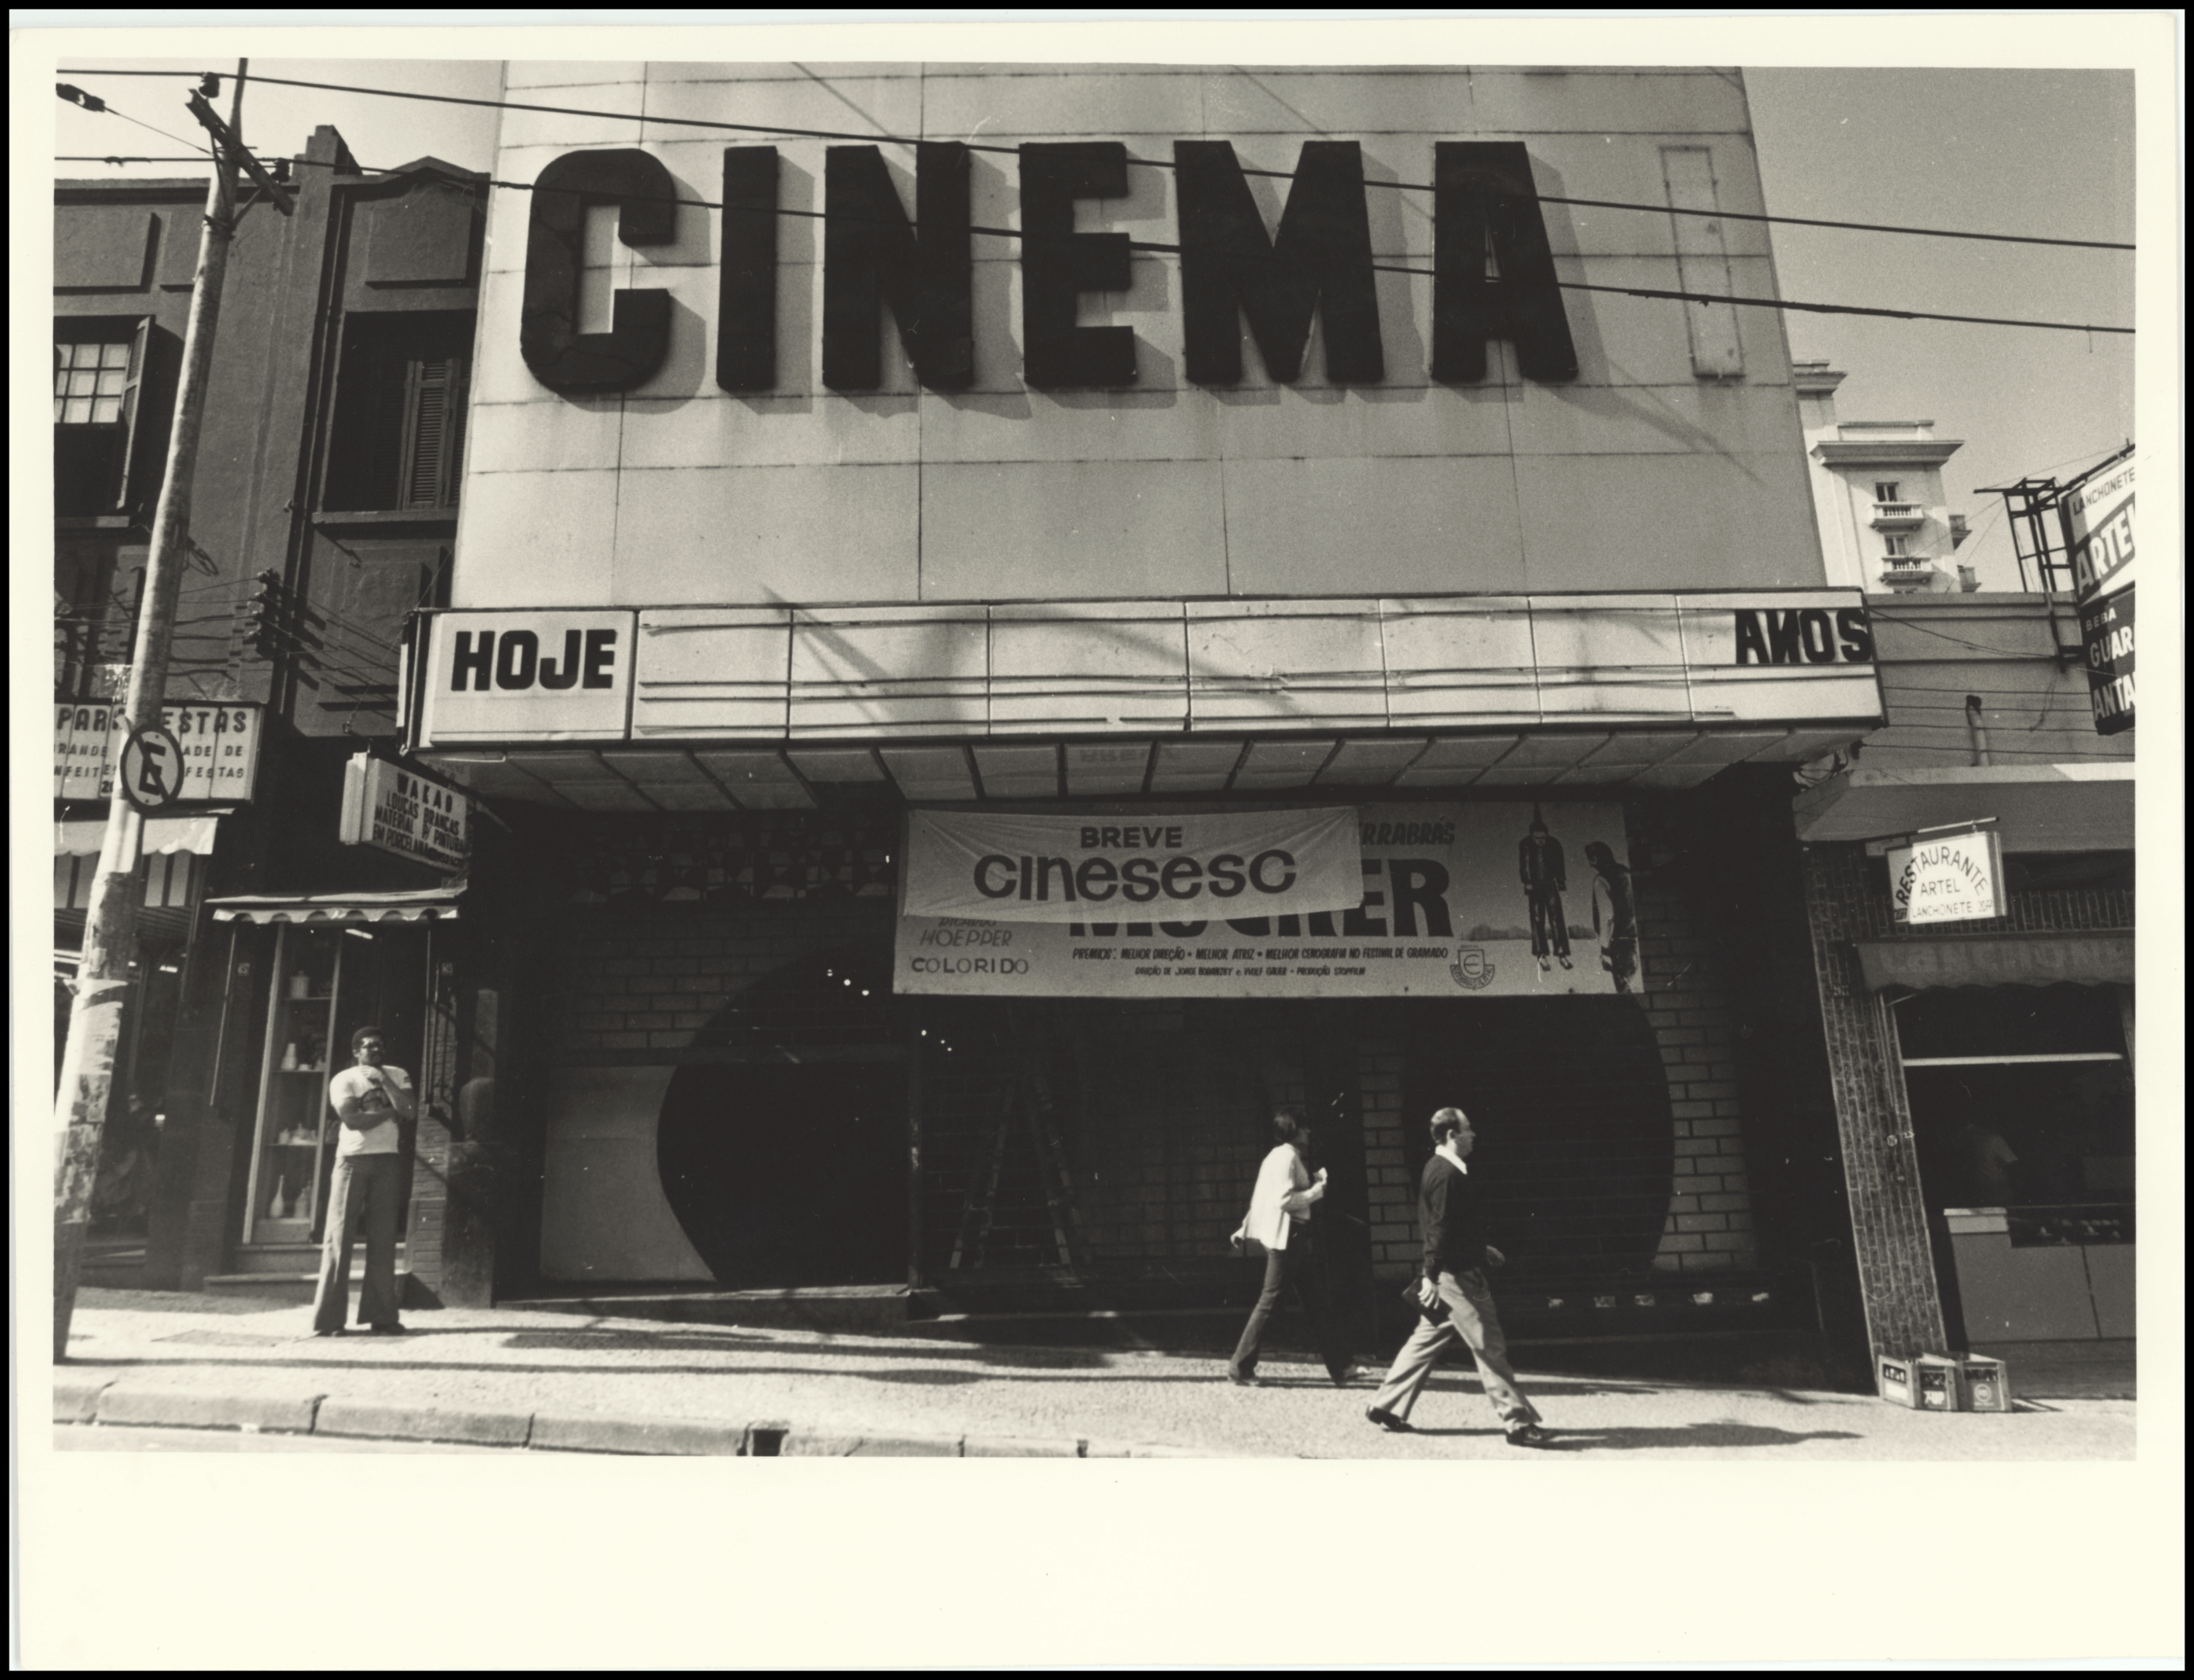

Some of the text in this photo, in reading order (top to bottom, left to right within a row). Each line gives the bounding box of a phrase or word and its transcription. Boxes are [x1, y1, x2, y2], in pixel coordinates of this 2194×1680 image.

[521, 140, 1579, 396] CINEMA
[2072, 467, 2135, 516] LANCHONETE
[2085, 608, 2117, 632] BEBA
[2089, 626, 2135, 668] GUAR
[451, 628, 618, 691] HOJE
[2093, 671, 2135, 721] ANTA
[161, 711, 247, 735] ESTAS
[54, 742, 243, 758] RANDE ADE DE
[54, 765, 244, 778] NFEITE FESTAS
[397, 772, 453, 813] WAKAO
[373, 824, 385, 840] EM
[375, 805, 414, 835] MATERIAL
[423, 807, 460, 836] BRANCAS
[1359, 816, 1455, 845] RRABRÁS
[1080, 825, 1183, 849] BREVE
[974, 849, 1297, 902] cinesesc
[1895, 845, 1989, 906] RESTAURANTE
[1920, 879, 1961, 897] ARTEL
[1911, 901, 1973, 918] LANCHONETE
[920, 929, 1012, 946] HOEPPER
[911, 957, 1028, 974] COLORIDO
[1120, 948, 1151, 960] MELHOR
[1153, 946, 1185, 961] DIREÇÃO
[1196, 948, 1228, 960] MELHOR
[1232, 948, 1256, 960] ATRIZ
[1265, 948, 1299, 960] MELHOR
[1301, 947, 1346, 959] CENOGRAFIA
[1349, 947, 1360, 959] NO
[1362, 947, 1394, 959] FESTIVAL
[1394, 947, 1404, 958] DE
[1406, 947, 1448, 959] GRAMADO
[1163, 967, 1172, 975] DE
[1175, 967, 1196, 975] JORGE
[1244, 967, 1263, 976] WOLF
[1266, 967, 1287, 975] GAUER
[1297, 965, 1330, 977] PRODUÇÃO
[1334, 966, 1366, 975] STOPFILM
